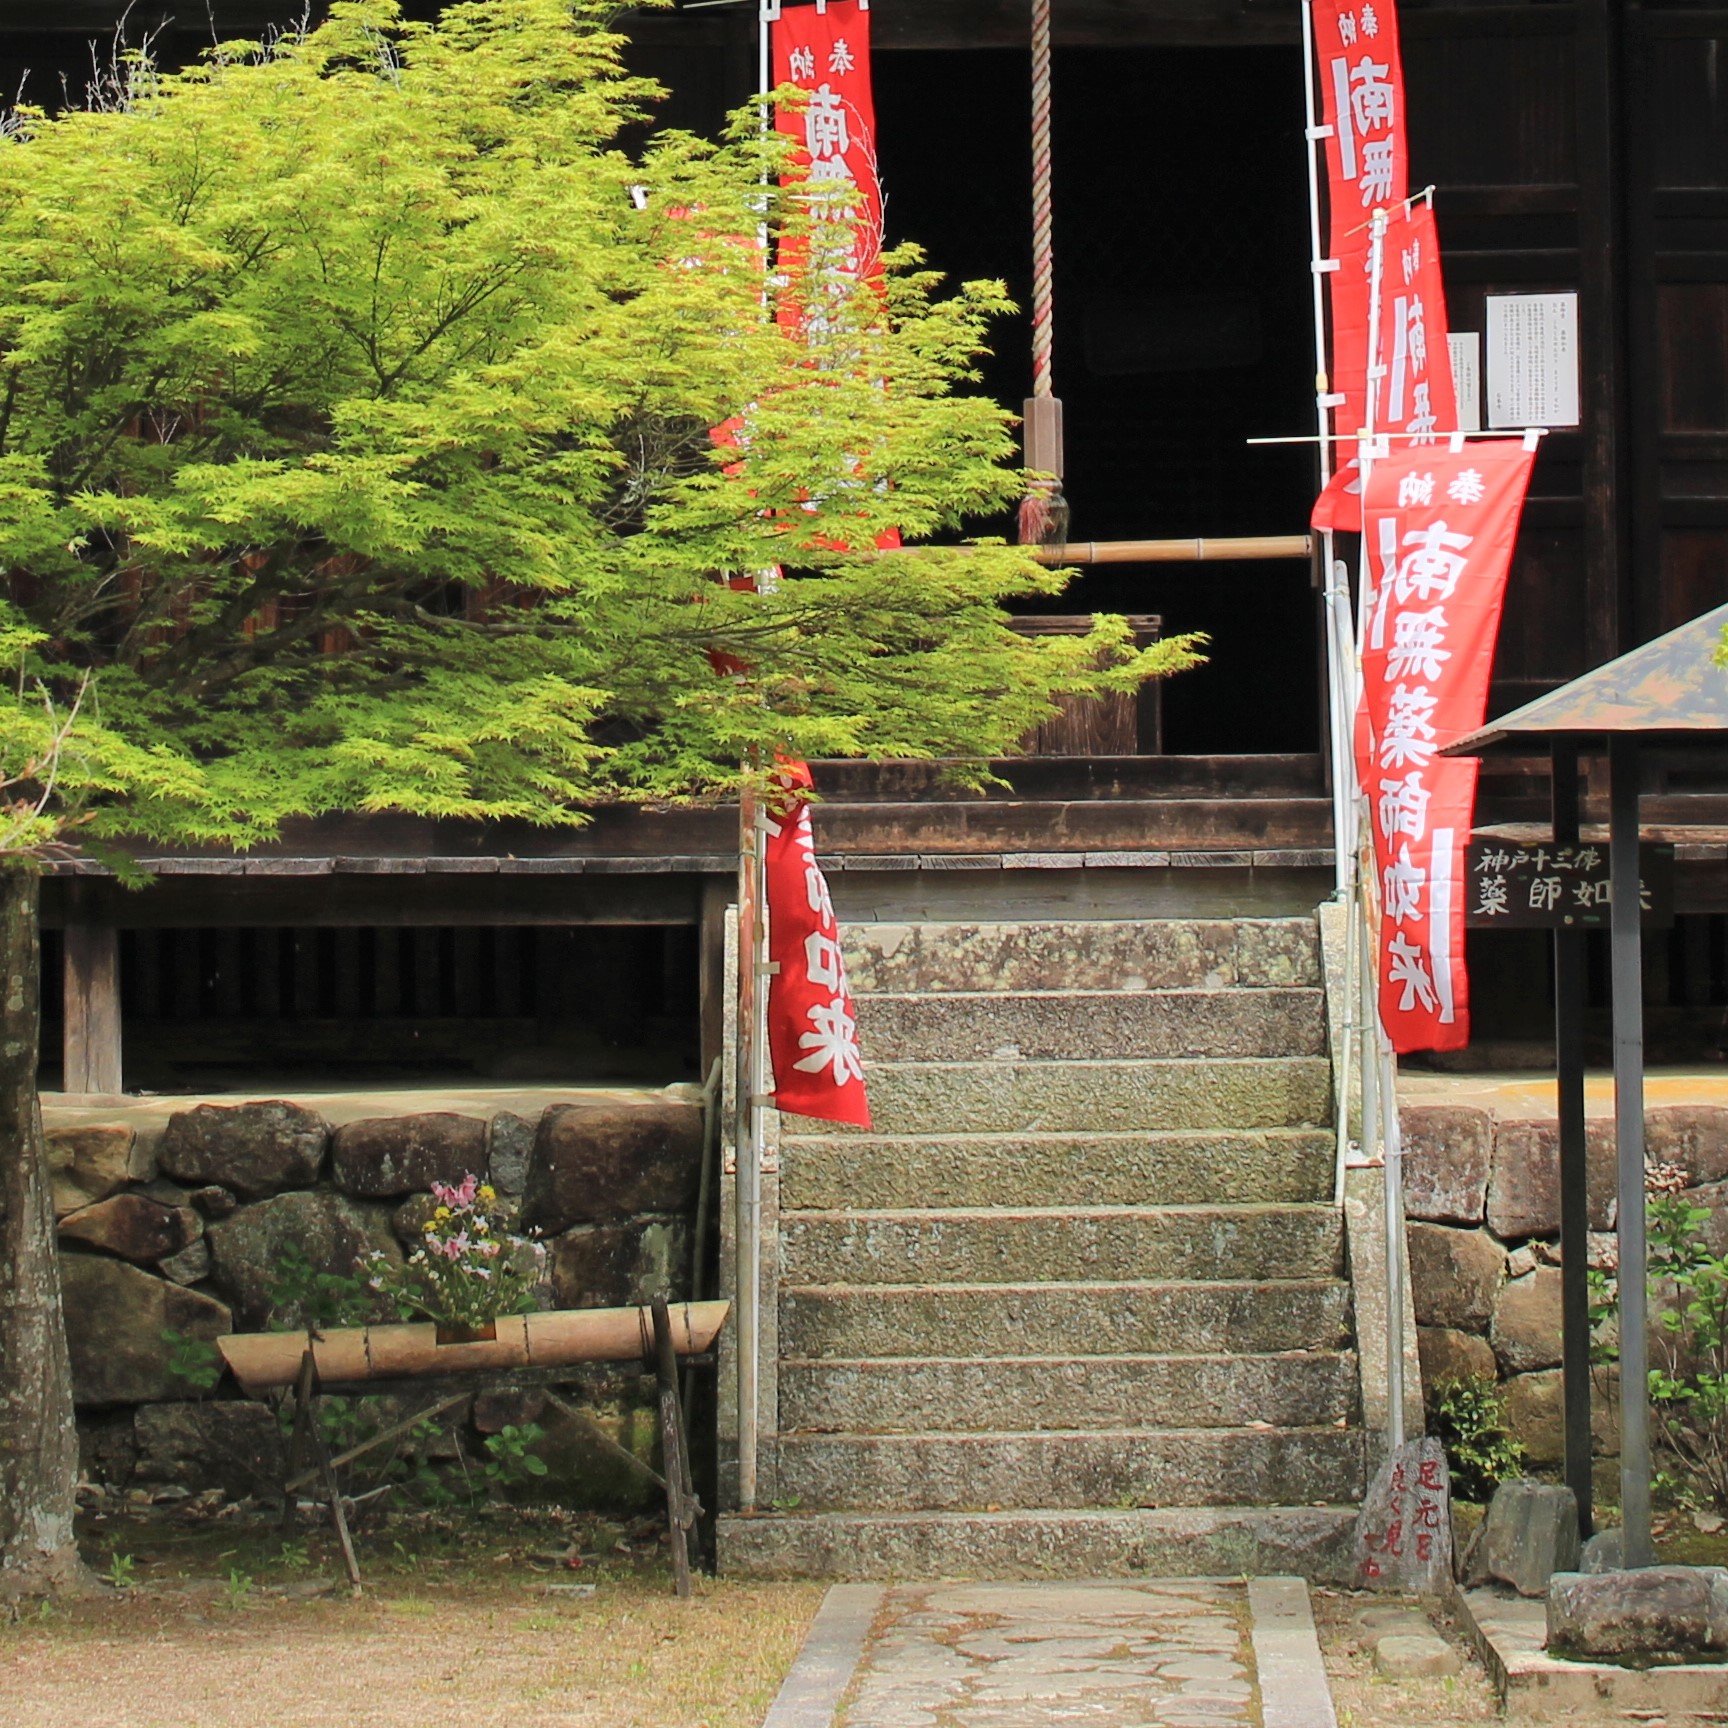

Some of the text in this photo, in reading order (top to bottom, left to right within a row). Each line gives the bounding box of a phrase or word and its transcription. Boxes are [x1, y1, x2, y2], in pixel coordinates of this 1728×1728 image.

[1474, 846, 1602, 873] 神戸十三佛
